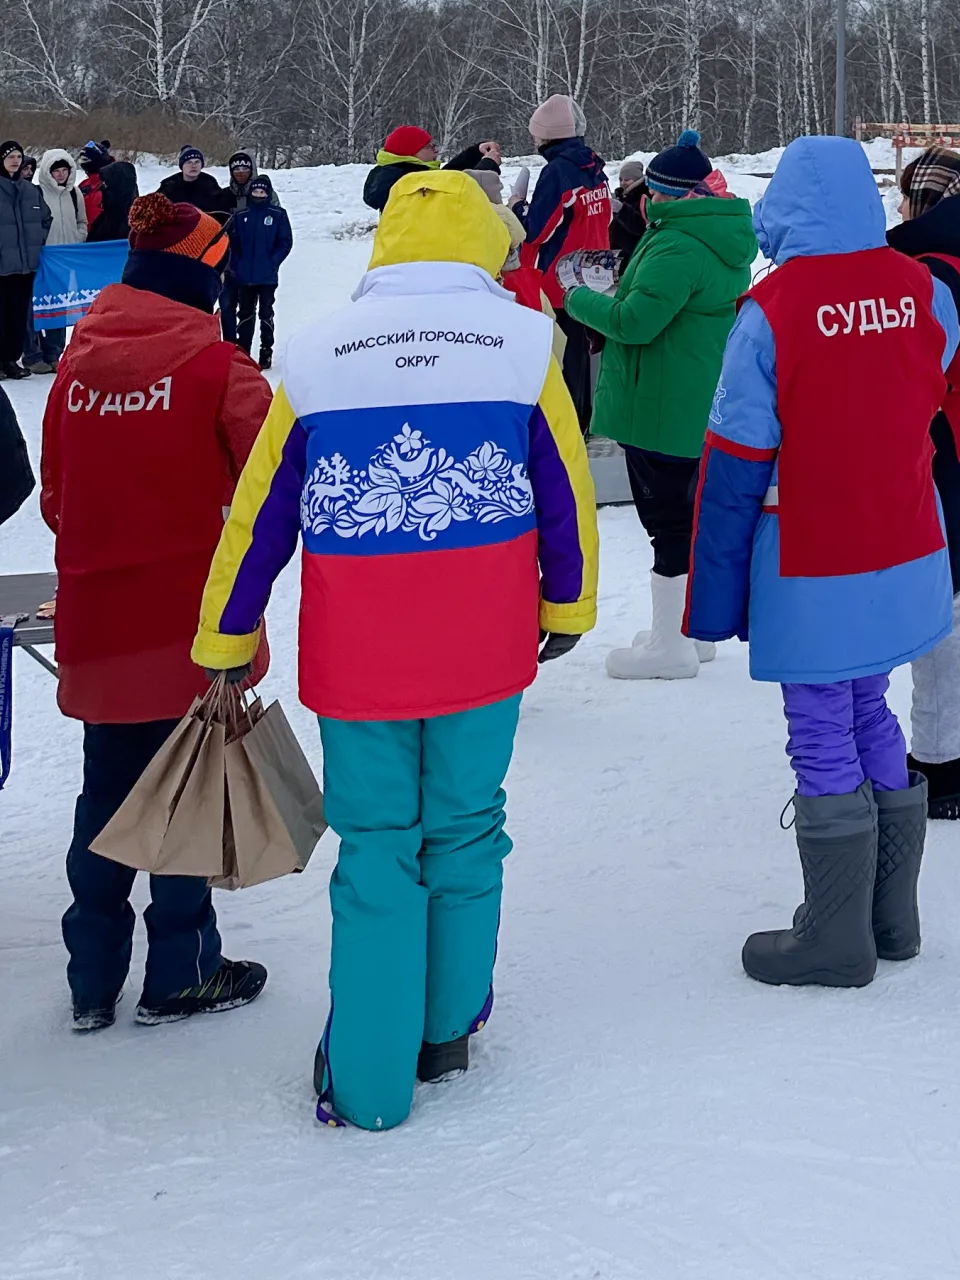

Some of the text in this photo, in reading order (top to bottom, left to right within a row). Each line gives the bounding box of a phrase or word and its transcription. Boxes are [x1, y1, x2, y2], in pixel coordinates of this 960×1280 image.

[816, 296, 917, 337] СУДЬЯ
[334, 329, 504, 357] МИАССКИЙ ГОРОДСКОЙ
[395, 355, 440, 368] ОКРУГ
[67, 375, 172, 416] СУДЬЯ
